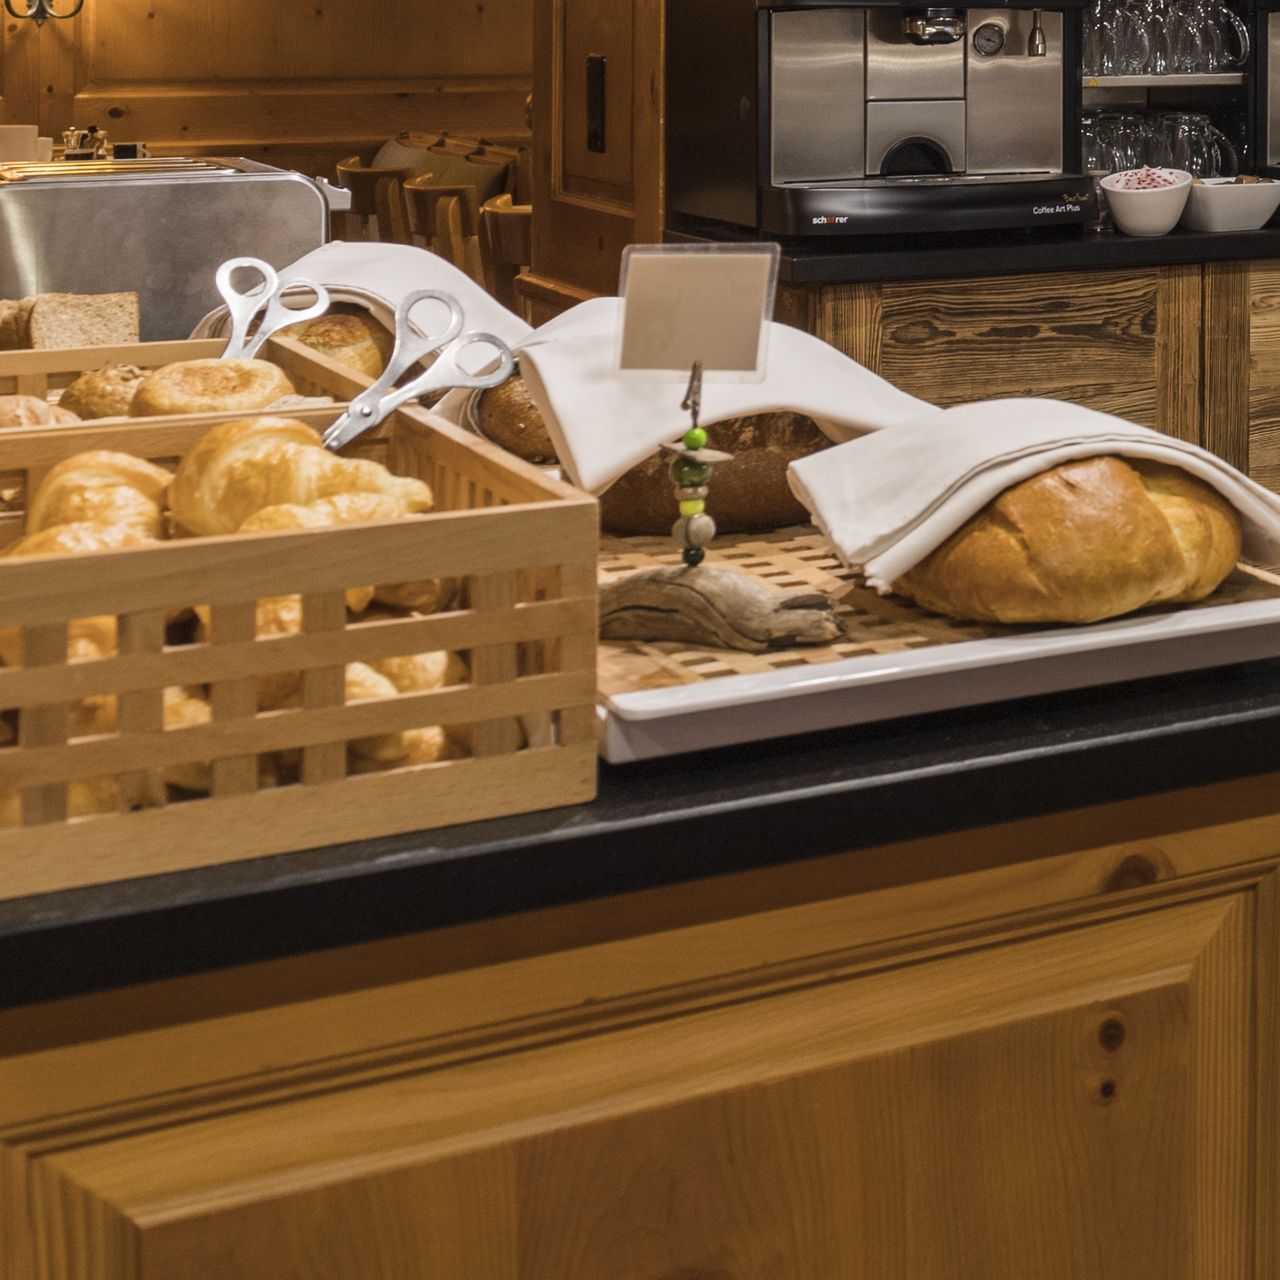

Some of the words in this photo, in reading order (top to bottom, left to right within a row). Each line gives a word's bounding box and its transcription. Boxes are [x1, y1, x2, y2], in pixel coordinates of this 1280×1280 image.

[1033, 206, 1054, 214] Coffee
[1055, 205, 1065, 213] Art
[1066, 204, 1080, 212] Plus
